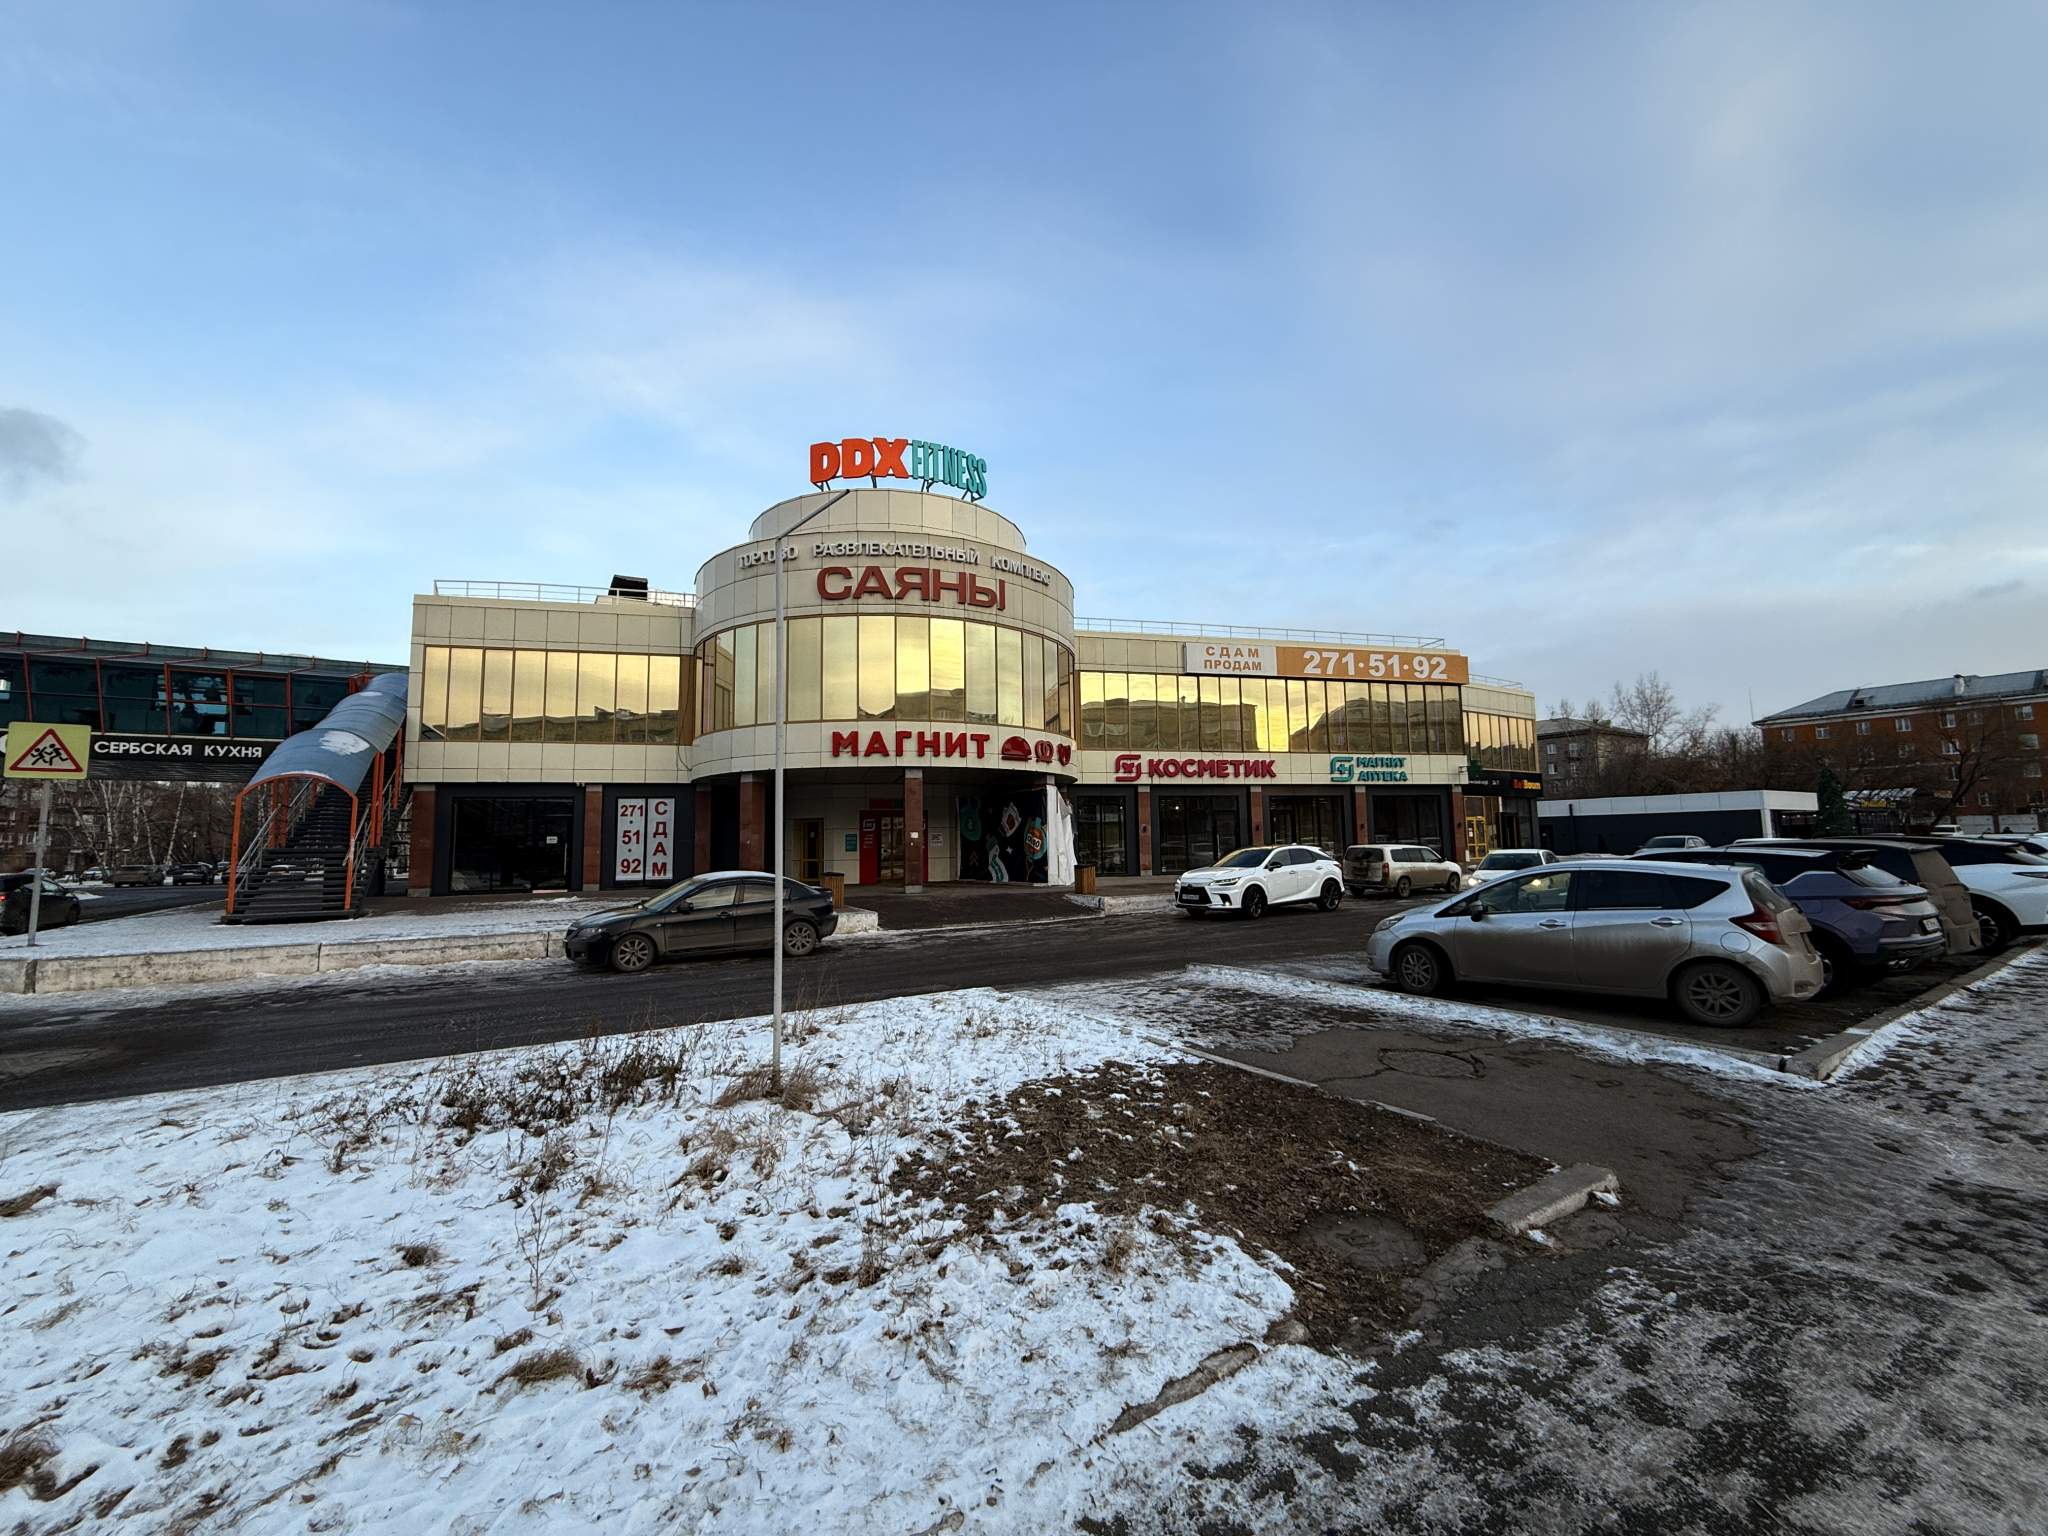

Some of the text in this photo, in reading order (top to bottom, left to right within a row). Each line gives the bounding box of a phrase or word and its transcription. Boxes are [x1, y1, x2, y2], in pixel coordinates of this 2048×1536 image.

[810, 437, 987, 498] DDX FITNESS
[812, 541, 981, 565] РАЗВЛЕКАТЕЛЬНЫЙ
[816, 565, 1006, 610] САЯНЫ
[1205, 646, 1260, 659] СДАМ
[1203, 659, 1263, 672] ПРОДАМ
[94, 740, 262, 758] СЕРБСКАЯ КУХНЯ
[832, 730, 990, 759] МАГНИТ
[1148, 758, 1276, 778] КОСМЕТИК
[1357, 756, 1406, 768] МАГНИТ
[1358, 771, 1408, 782] АПТЕКА
[620, 805, 643, 816] 271
[622, 830, 640, 844] 51
[652, 801, 668, 876] СДАМ
[621, 858, 641, 873] 92
